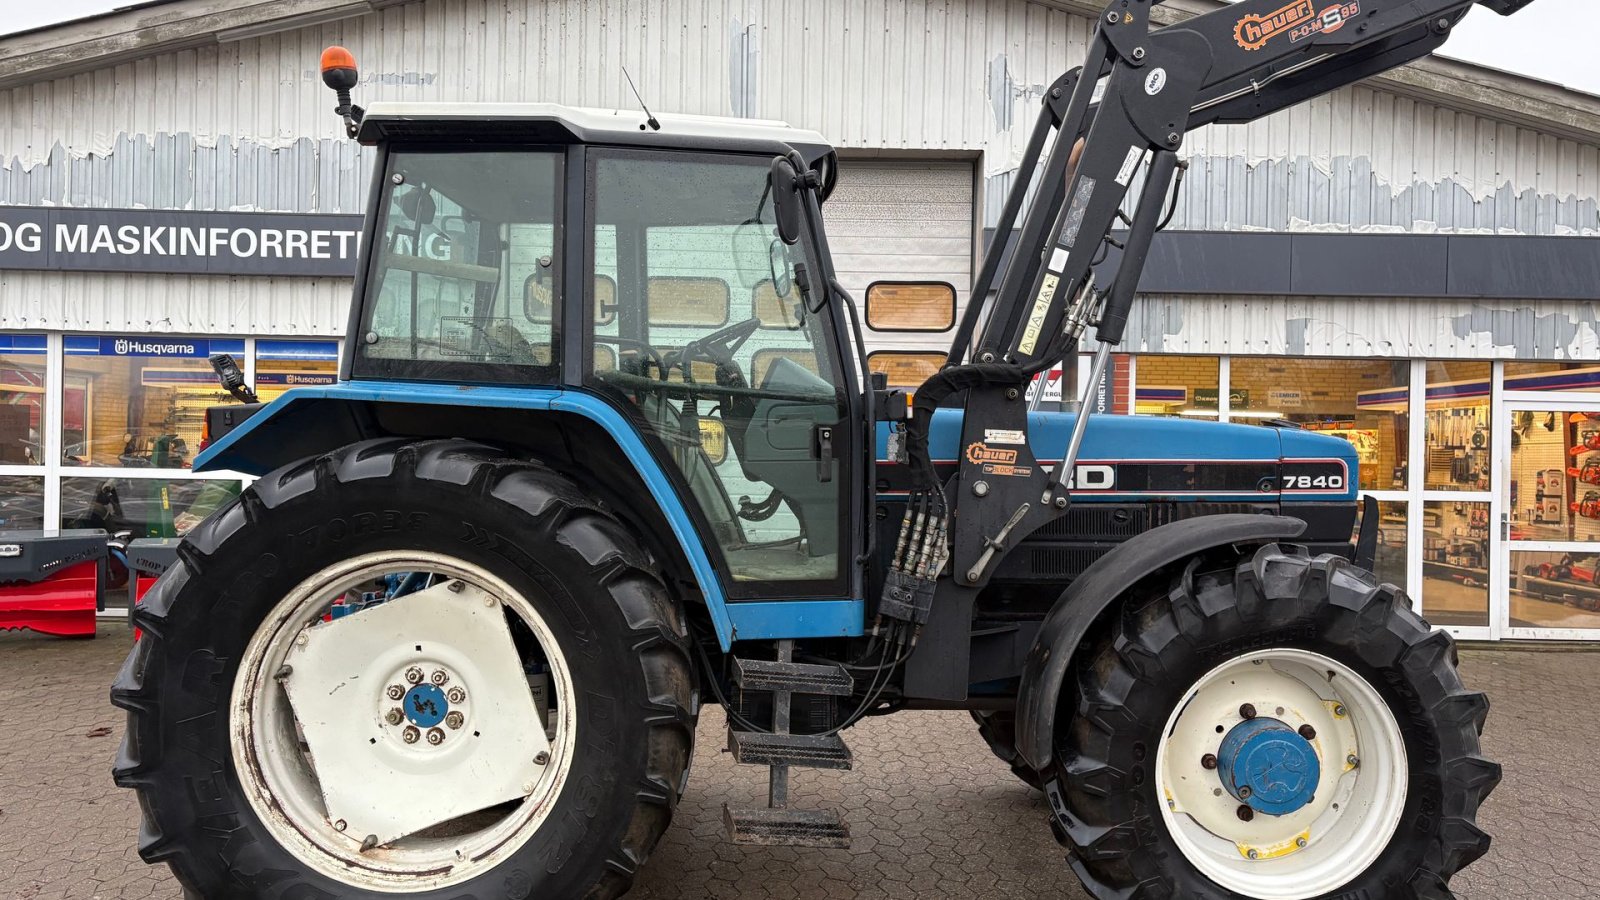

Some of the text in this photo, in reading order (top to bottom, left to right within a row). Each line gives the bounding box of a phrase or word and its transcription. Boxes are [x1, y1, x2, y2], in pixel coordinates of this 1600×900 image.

[55, 223, 451, 261] MASKINFORRETNG
[129, 341, 194, 355] Husqvarna
[294, 375, 332, 384] Husqvarna
[1283, 475, 1343, 489] 7840
